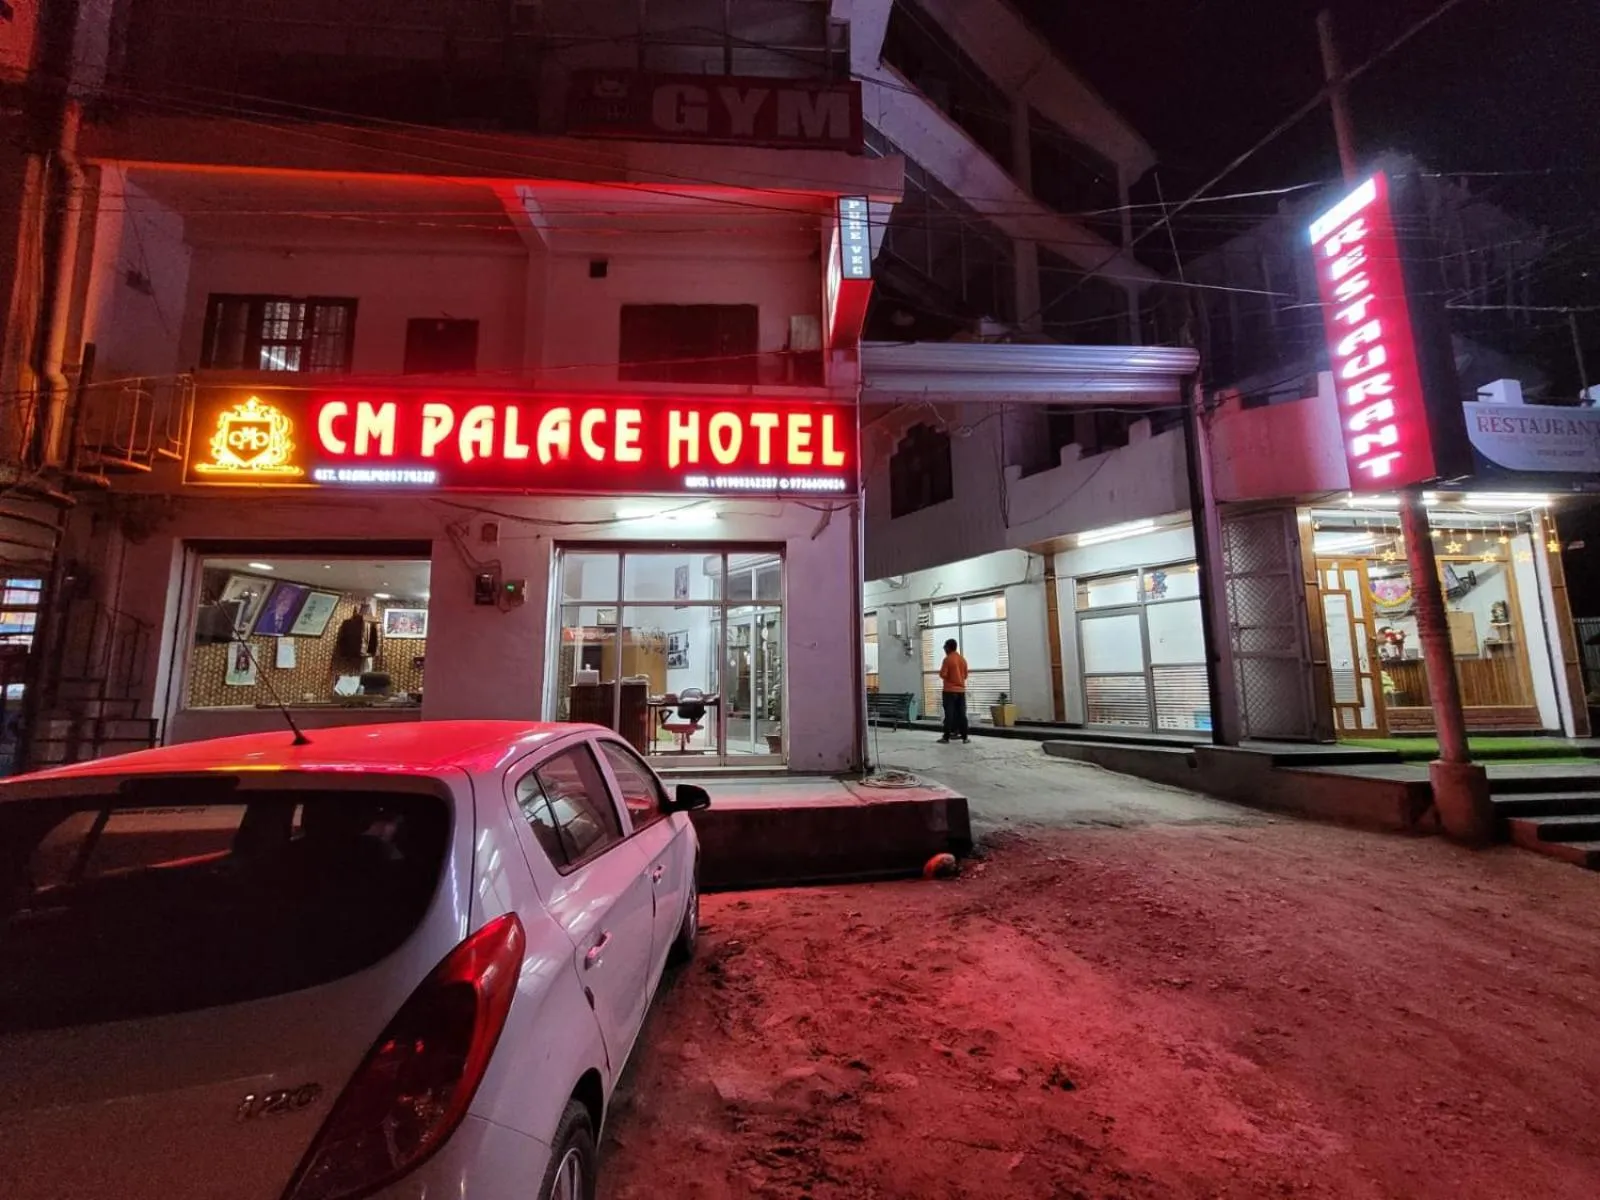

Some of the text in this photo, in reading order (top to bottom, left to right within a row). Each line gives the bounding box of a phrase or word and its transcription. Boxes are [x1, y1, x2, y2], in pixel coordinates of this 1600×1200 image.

[652, 83, 851, 139] GYM
[848, 200, 863, 275] PURE VEG
[1322, 217, 1402, 479] RESTAURANT
[317, 401, 845, 469] CM PALACE HOTEL
